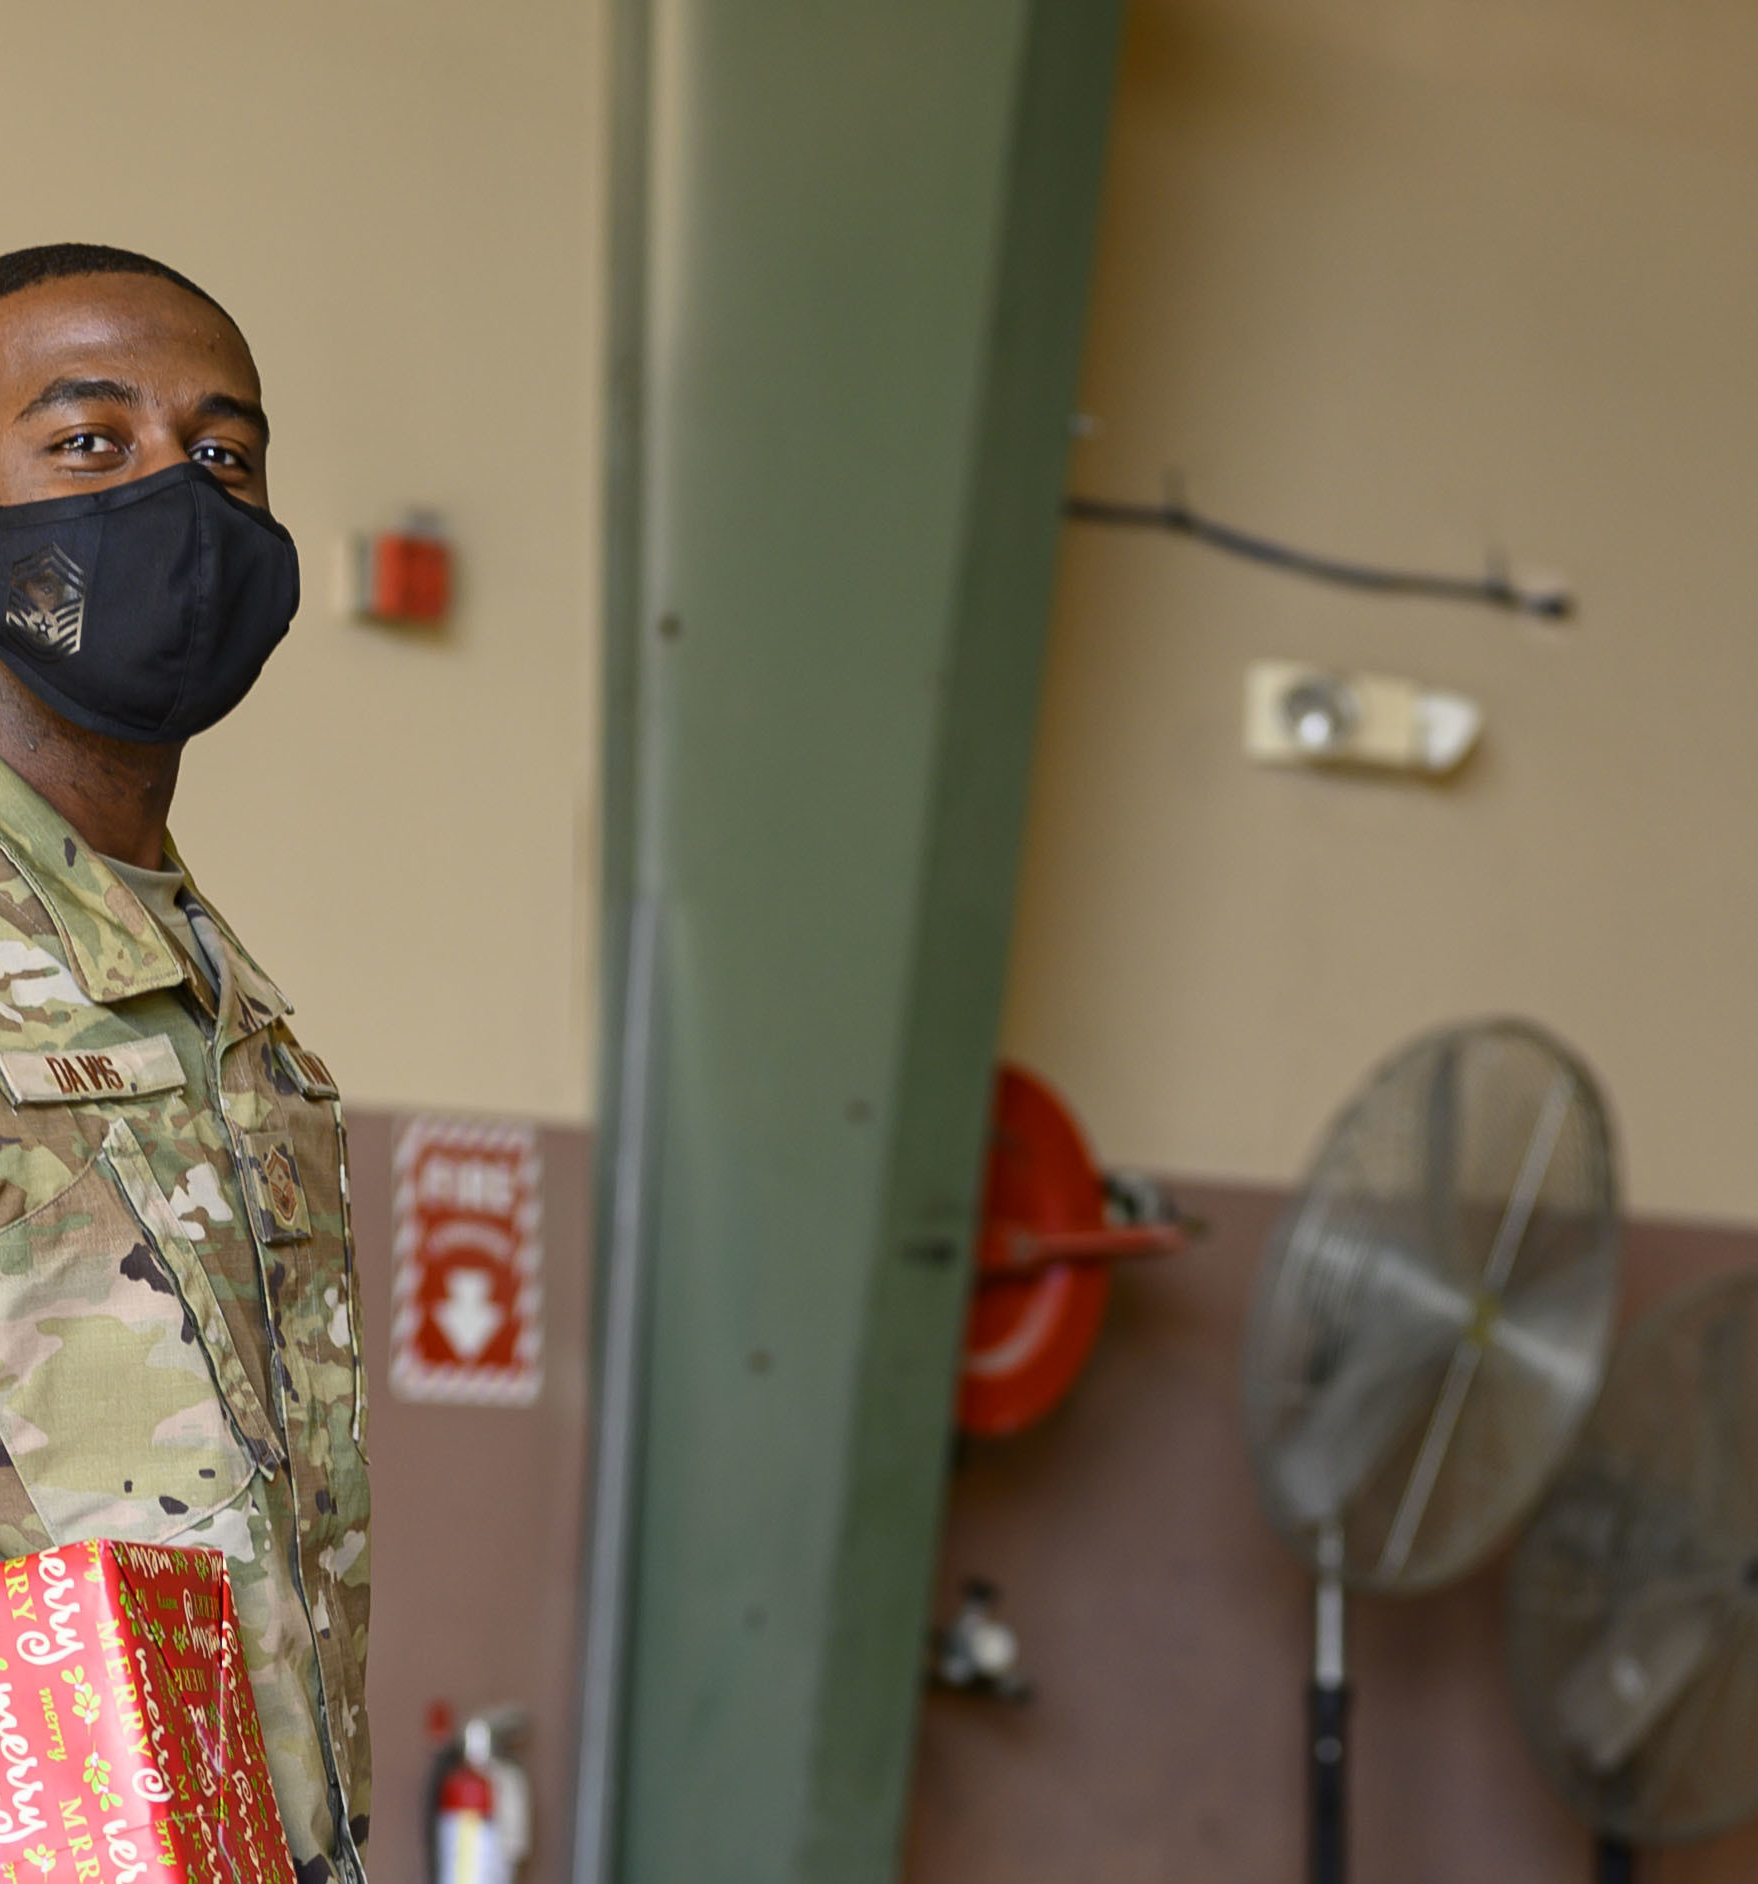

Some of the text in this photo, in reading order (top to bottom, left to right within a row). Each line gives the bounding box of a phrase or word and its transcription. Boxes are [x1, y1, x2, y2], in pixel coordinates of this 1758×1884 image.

[45, 1055, 123, 1093] DAVIS
[39, 1688, 68, 1763] merry
[97, 1619, 153, 1760] MERRY
